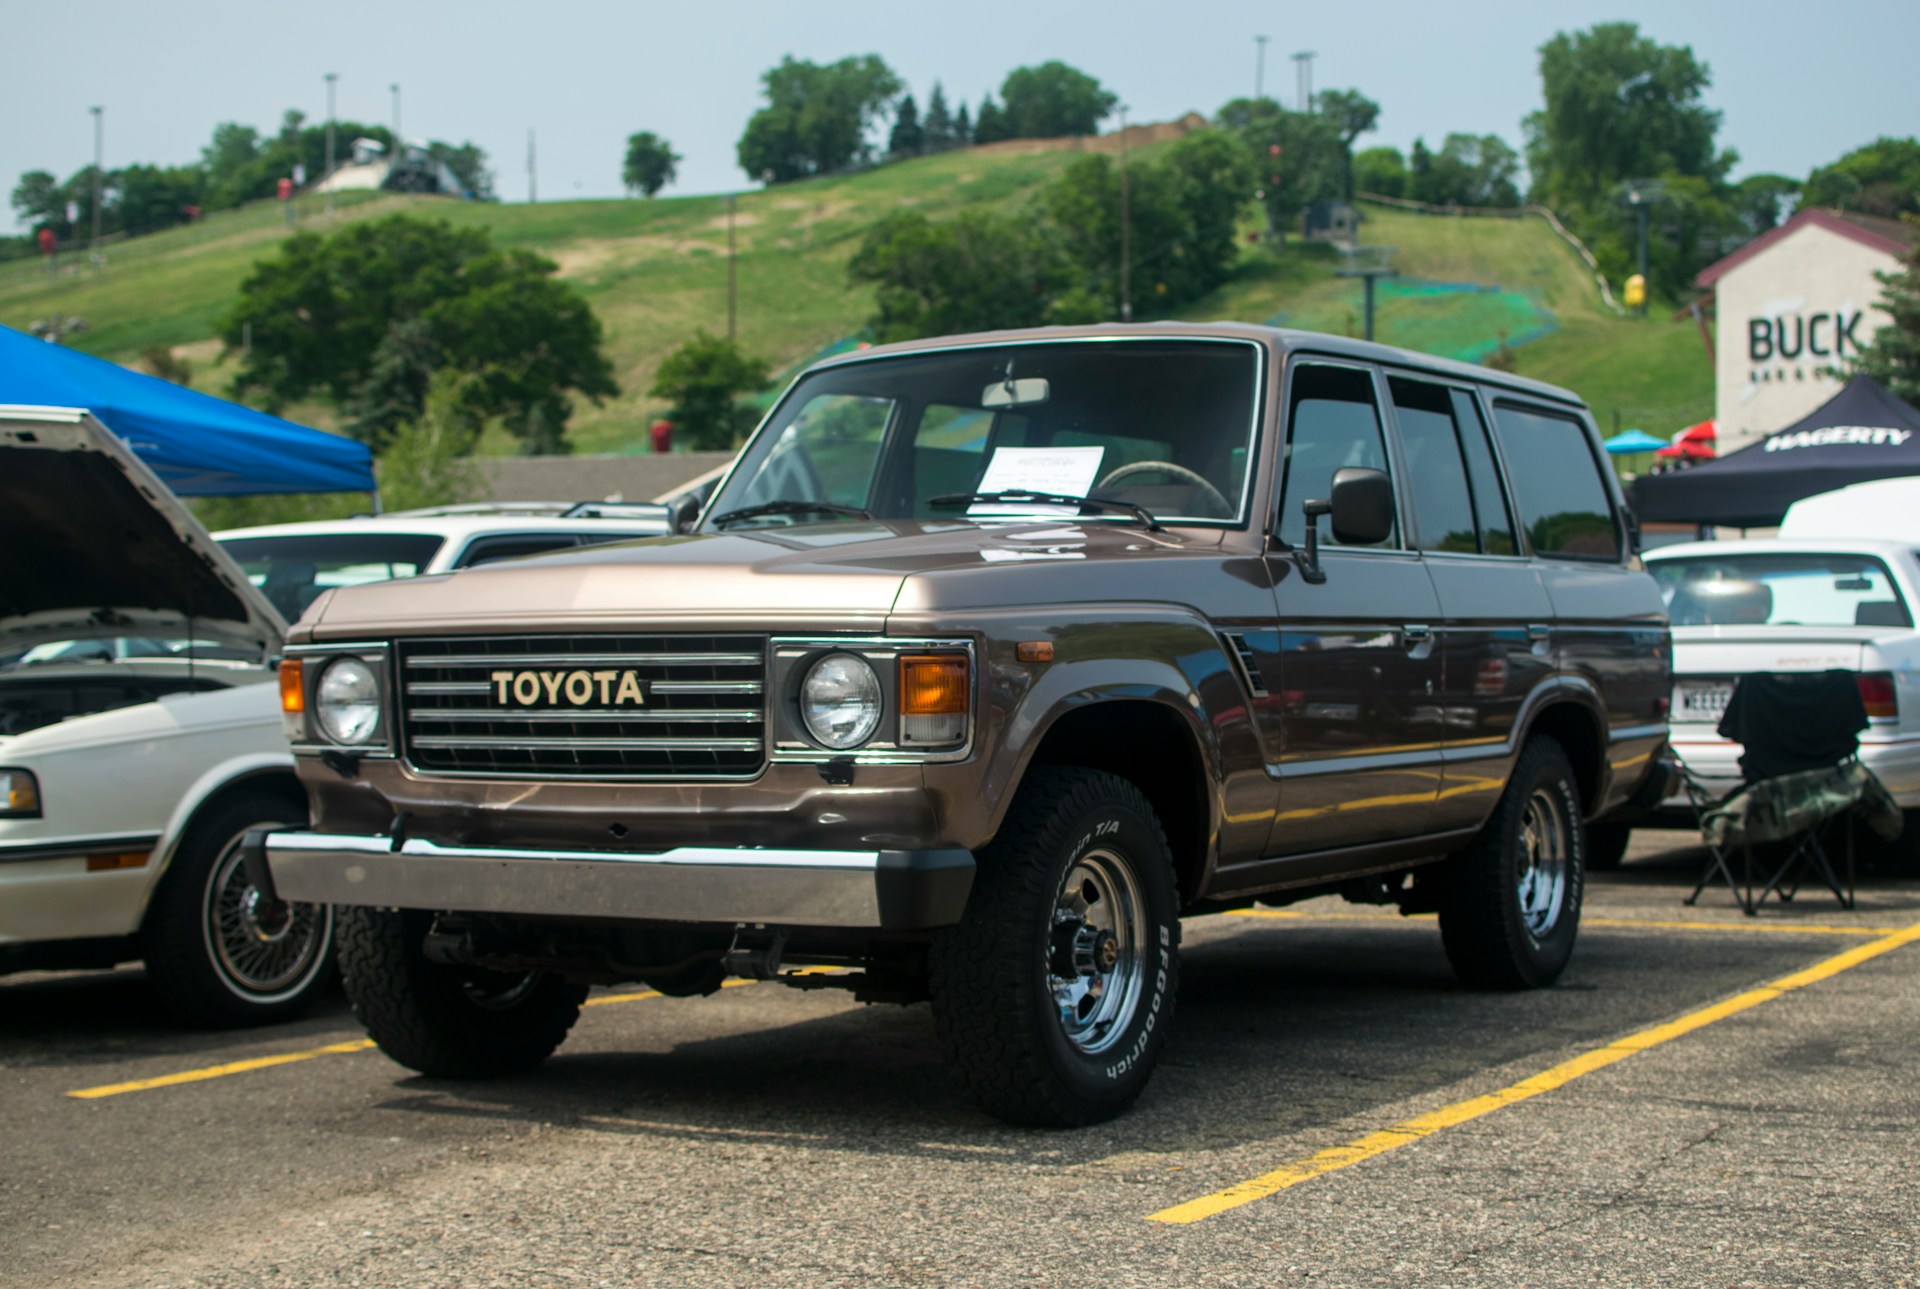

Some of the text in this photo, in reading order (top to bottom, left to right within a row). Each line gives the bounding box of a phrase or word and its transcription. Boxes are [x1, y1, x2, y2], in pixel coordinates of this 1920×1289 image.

[1749, 312, 1863, 362] BUCK
[1765, 426, 1912, 452] HAGERTY
[491, 669, 644, 706] TOYOTA
[1096, 820, 1119, 835] T/A
[1106, 924, 1170, 1079] BFGoodrich
